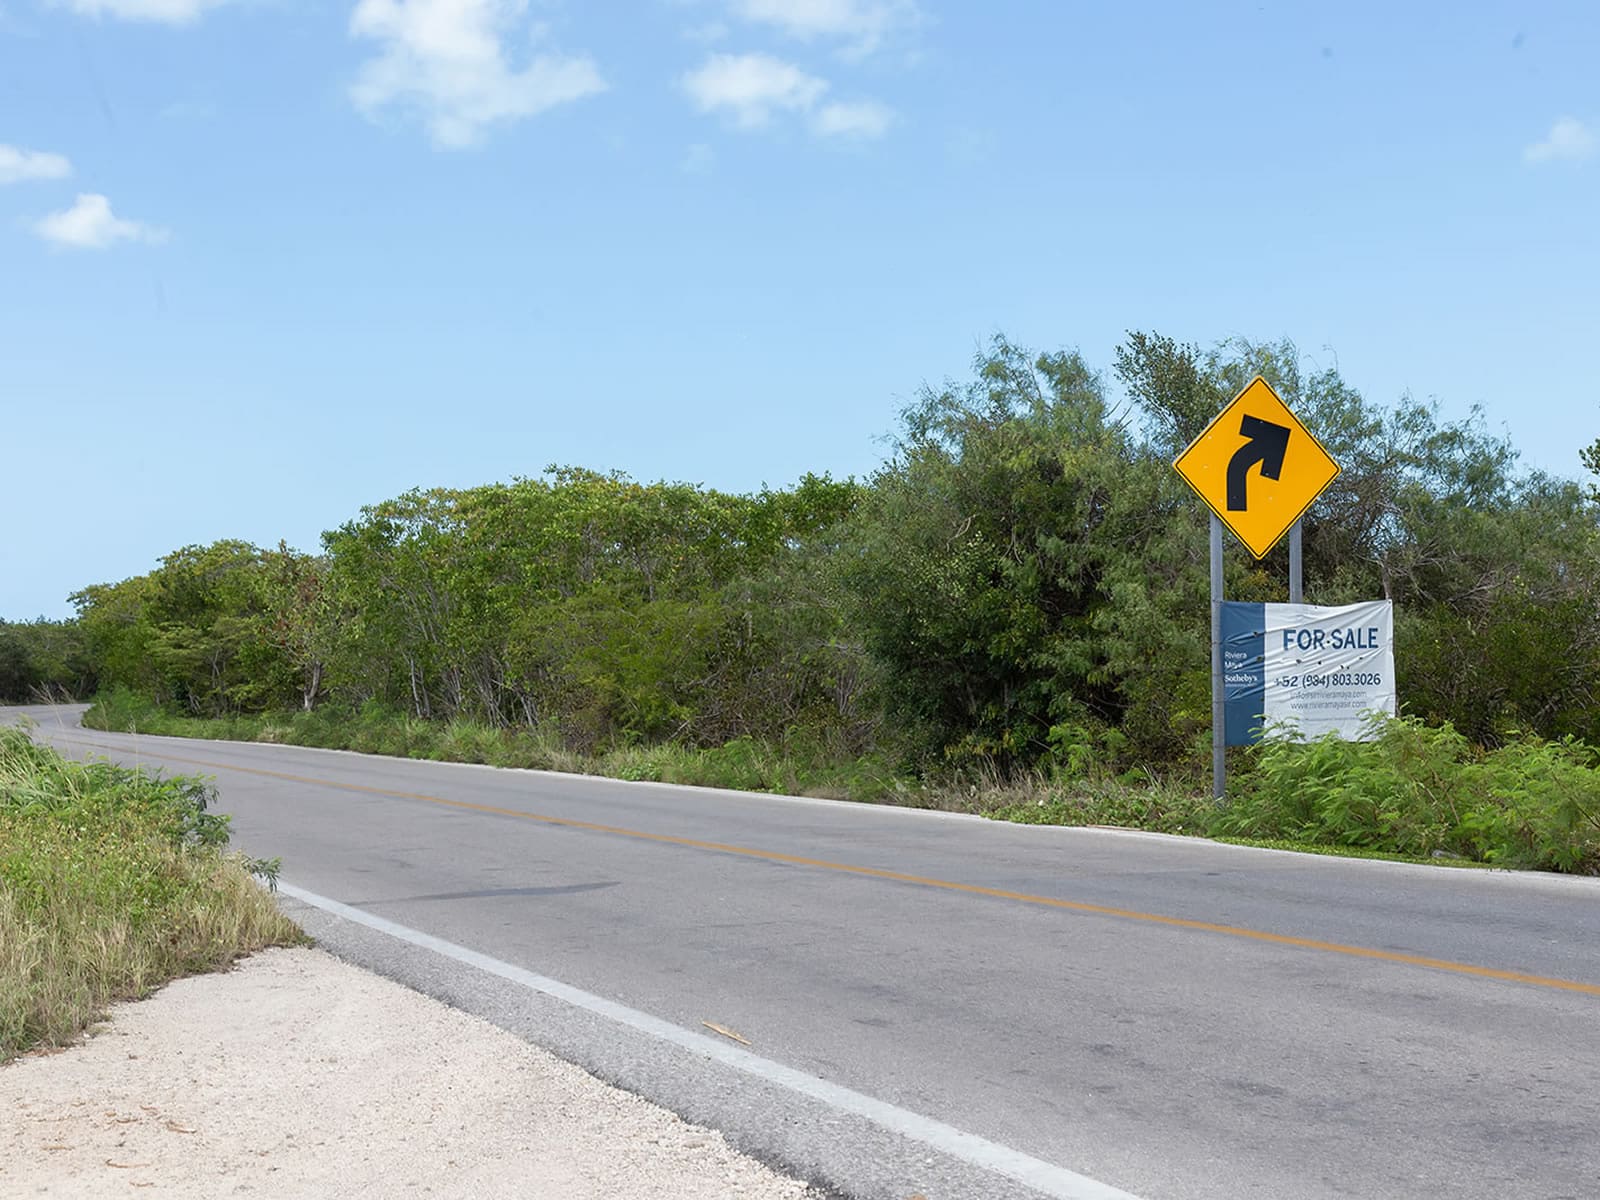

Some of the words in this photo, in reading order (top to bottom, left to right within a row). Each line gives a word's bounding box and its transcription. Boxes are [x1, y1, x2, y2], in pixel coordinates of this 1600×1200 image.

[1283, 628, 1326, 651] FOR
[1331, 627, 1379, 649] SALE
[1224, 651, 1248, 660] Riviera
[1224, 673, 1258, 684] Sotheby's
[1275, 675, 1298, 688] +52
[1302, 674, 1330, 689] (984)
[1332, 673, 1381, 686] 803.3026
